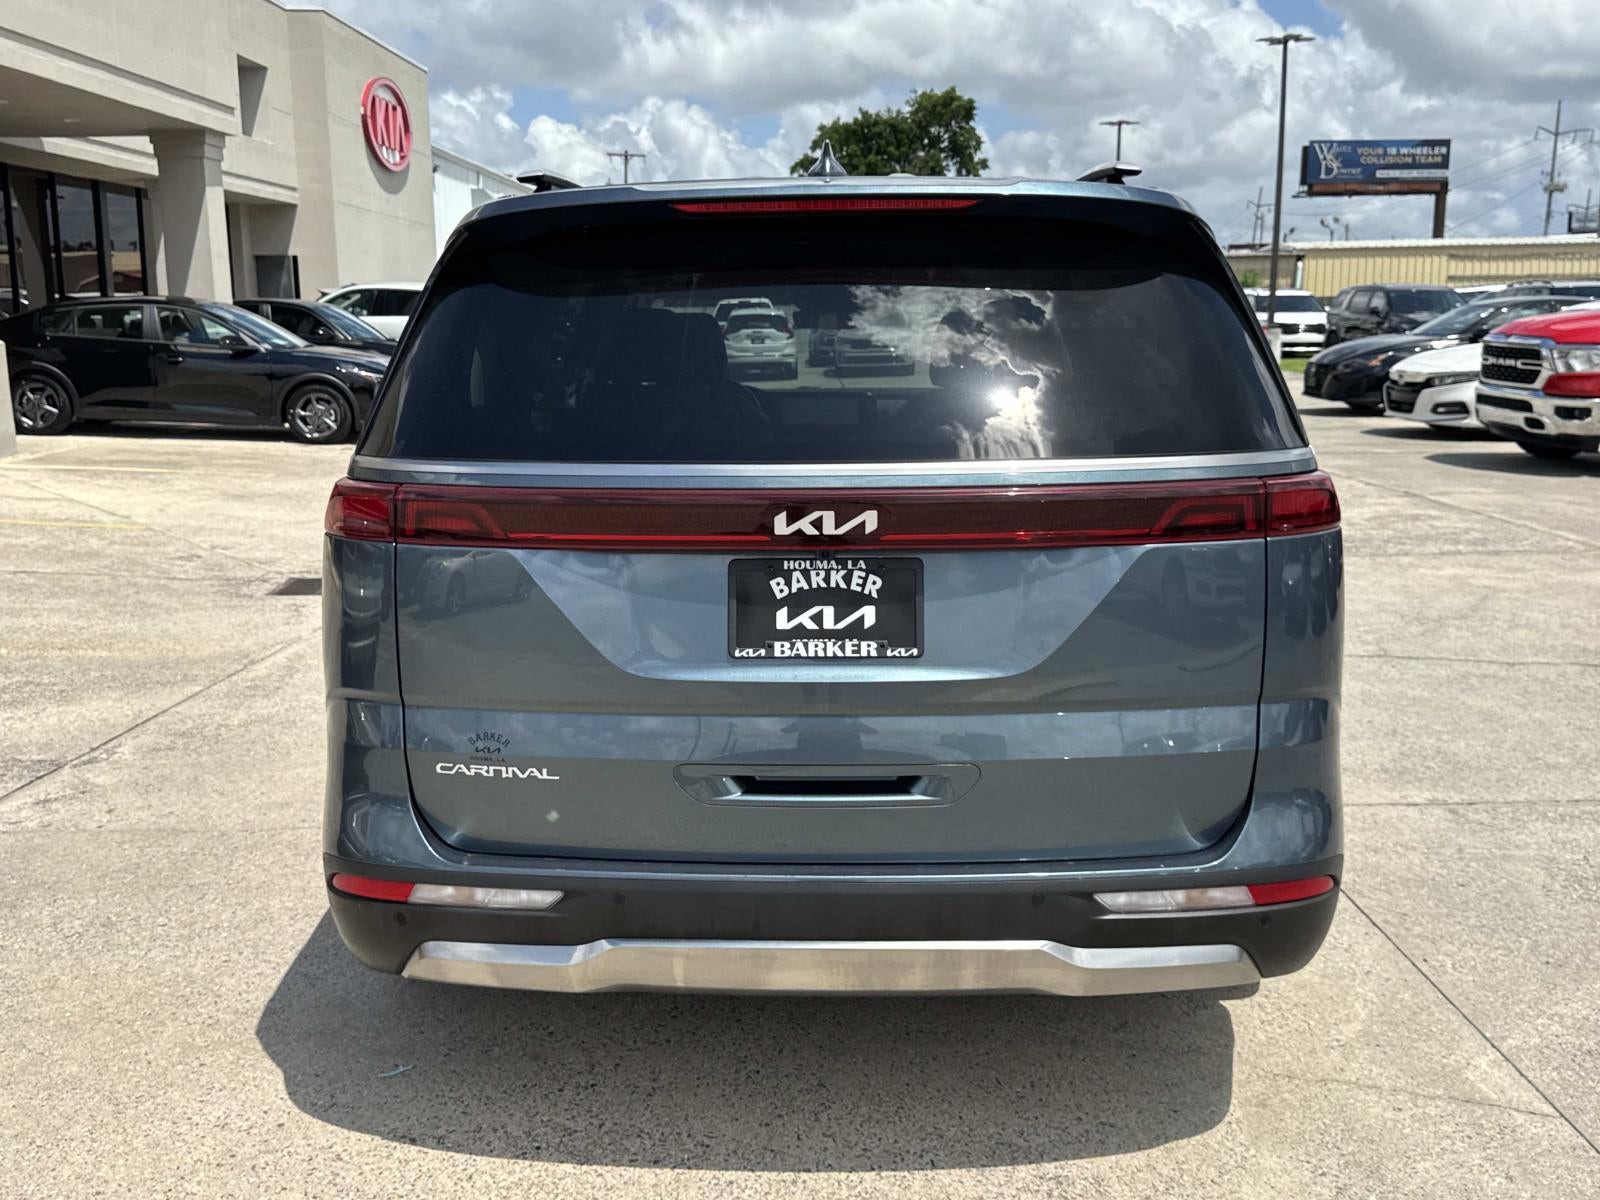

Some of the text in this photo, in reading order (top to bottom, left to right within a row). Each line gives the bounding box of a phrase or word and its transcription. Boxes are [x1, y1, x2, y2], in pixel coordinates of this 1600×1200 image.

[373, 94, 407, 155] KIA
[1357, 147, 1384, 155] YOUR
[1399, 146, 1448, 155] WHEELER
[1360, 156, 1443, 164] COLLISION TEAM
[774, 509, 878, 535] KIA
[783, 560, 867, 570] HOUMA, LA
[769, 569, 883, 600] BARKER
[776, 605, 876, 630] KIA
[734, 647, 766, 657] KIA
[773, 641, 878, 657] BARKER
[887, 647, 918, 657] KIA
[467, 731, 511, 749] BARKER
[475, 746, 501, 755] KIA
[435, 762, 560, 780] CARNIVAL
